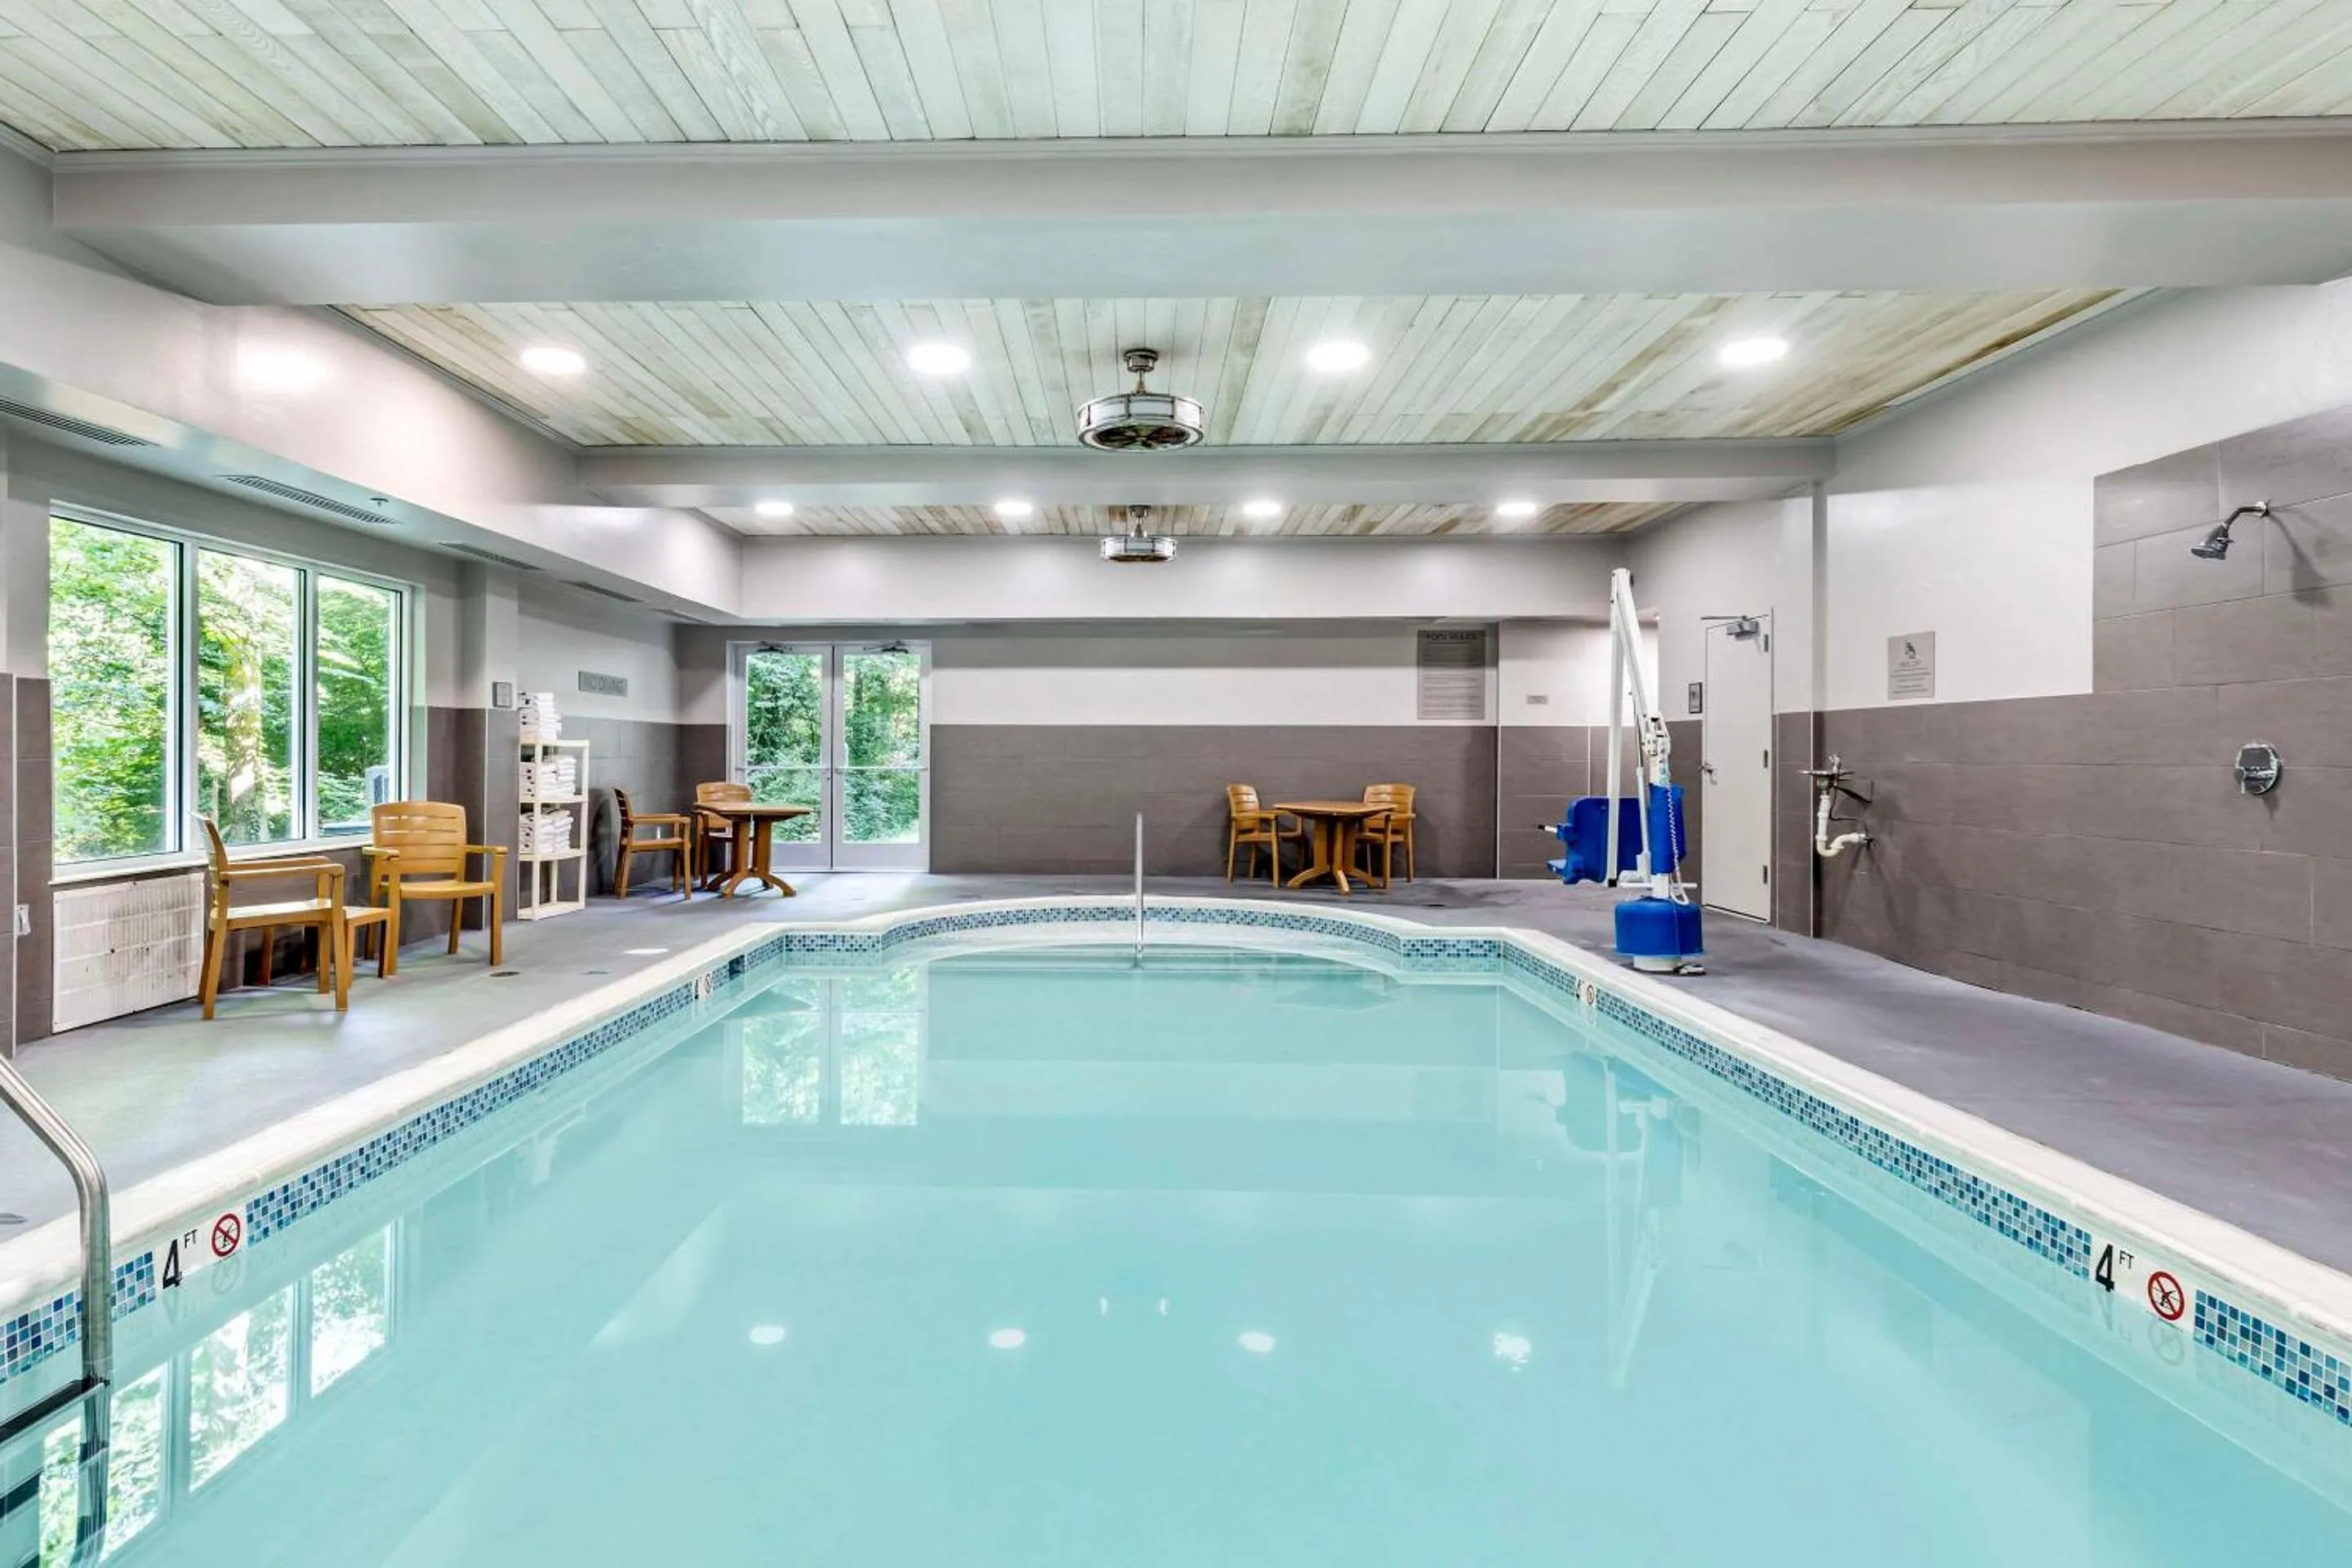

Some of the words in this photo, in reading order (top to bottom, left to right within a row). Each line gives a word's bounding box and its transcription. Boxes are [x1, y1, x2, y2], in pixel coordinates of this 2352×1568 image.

[163, 1238, 181, 1290] 4
[184, 1229, 198, 1250] FT
[2095, 1244, 2114, 1293] 4
[2118, 1250, 2134, 1269] FT
